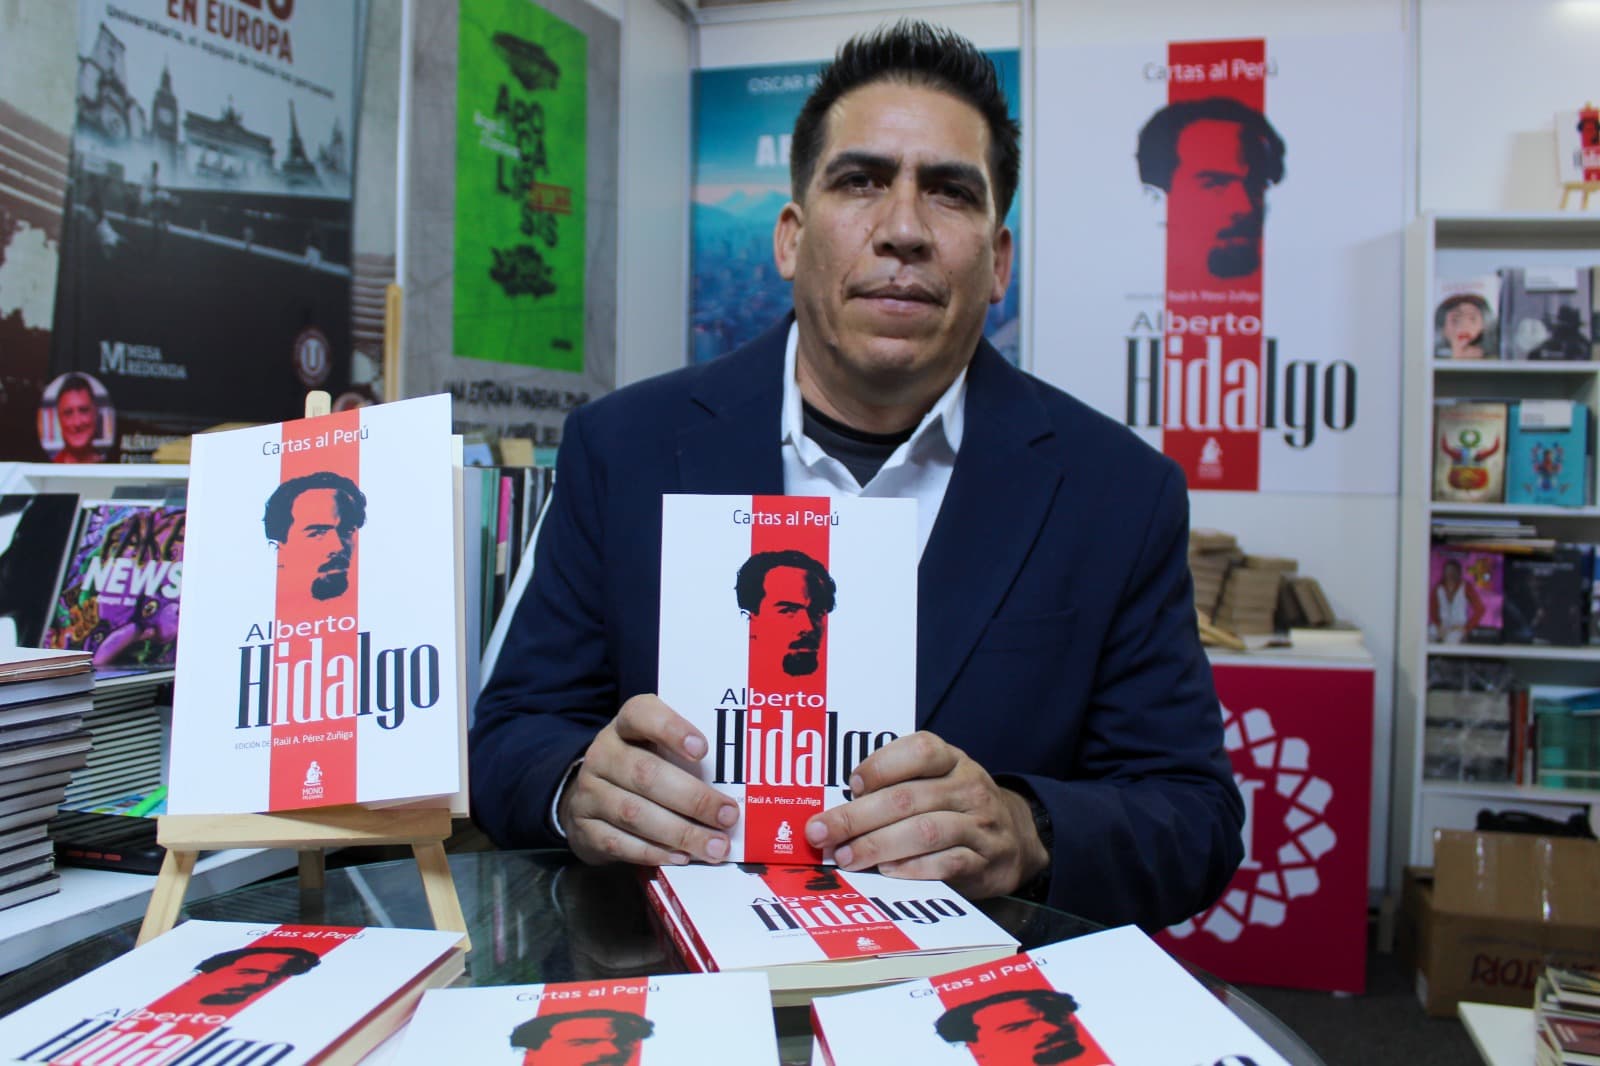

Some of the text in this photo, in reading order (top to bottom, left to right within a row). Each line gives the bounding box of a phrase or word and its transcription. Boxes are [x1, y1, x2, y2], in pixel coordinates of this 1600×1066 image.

[167, 0, 197, 26] EN
[206, 0, 293, 64] EUROPA
[1143, 56, 1279, 82] Cartas al Perú
[1131, 309, 1261, 336] Alberto
[1125, 335, 1358, 451] Hidalgo
[262, 425, 369, 456] Cartas al Perú
[733, 510, 839, 527] Cartas al Perú
[81, 555, 183, 599] NEWS
[245, 616, 356, 642] Alberto
[235, 631, 440, 730] Hidalgo
[720, 688, 825, 708] Alberto
[273, 737, 292, 747] Raúl
[293, 735, 301, 745] A.
[302, 734, 325, 743] Pérez
[326, 731, 354, 741] Zuñiga
[712, 708, 898, 802] Hidalg
[747, 795, 764, 804] Raúl
[774, 796, 795, 805] Pérez
[796, 797, 821, 807] Zuñiga
[752, 893, 861, 904] Alberto
[749, 896, 968, 932] Hidalgo
[246, 929, 365, 940] Cartas al Perú
[909, 956, 1048, 999] Cartas al Perú
[516, 981, 660, 1001] Cartas al Perú
[96, 1007, 227, 1025] Alberto
